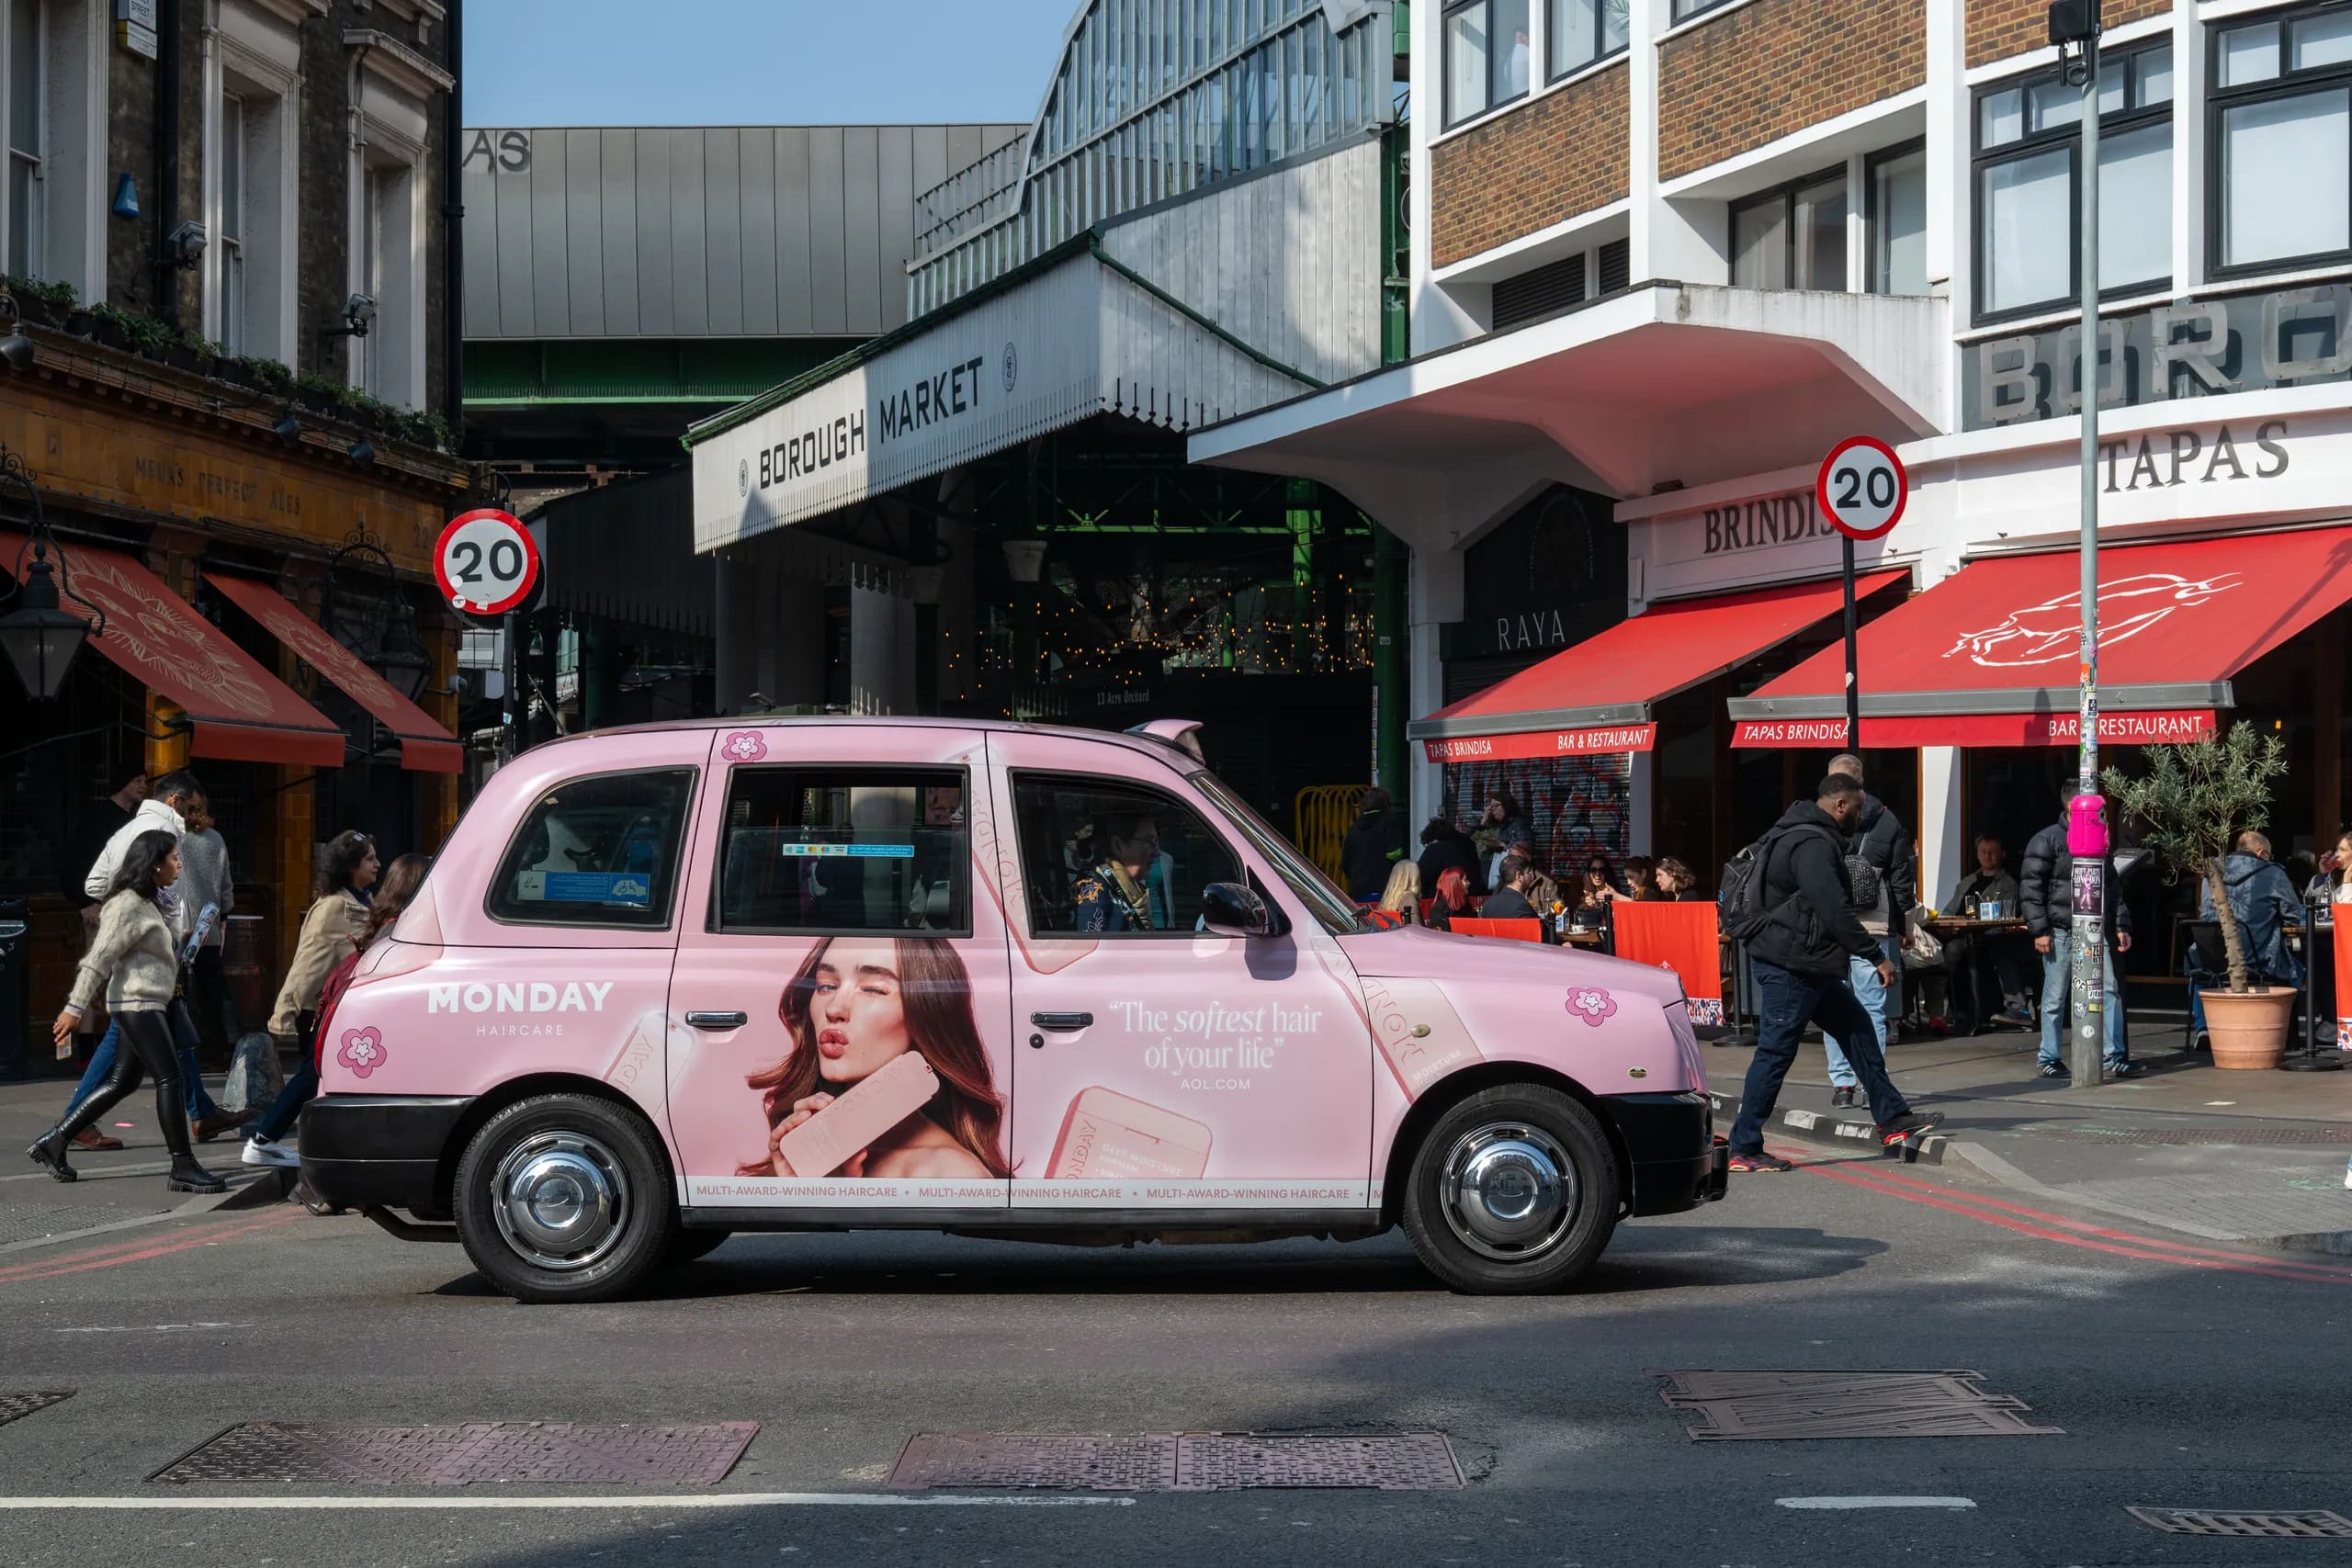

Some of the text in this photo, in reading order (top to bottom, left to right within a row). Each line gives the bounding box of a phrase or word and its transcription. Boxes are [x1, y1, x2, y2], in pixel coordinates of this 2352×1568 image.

[760, 409, 865, 490] BOROUGH
[879, 355, 983, 445] MARKET
[2098, 420, 2290, 494] TAPAS
[1834, 467, 1895, 509] 20
[452, 539, 523, 582] 20
[1498, 609, 1566, 652] RAYA
[1745, 724, 1849, 740] TAPAS BRINDISA
[2049, 719, 2077, 737] BAR
[2098, 716, 2203, 736] RESTAURANT
[1429, 739, 1493, 758] TAPAS BRINDISA
[1557, 728, 1650, 750] BAR & RESTAURANT
[426, 981, 615, 1014] MONDAY
[1173, 999, 1267, 1040] softest
[1272, 1001, 1323, 1033] hair
[476, 1025, 564, 1037] HAIRCARE
[1144, 1035, 1172, 1069] of
[1171, 1045, 1234, 1077] your
[1180, 1078, 1251, 1090] AOL.COM
[695, 1185, 898, 1198] MULTI-AWARD-WINNING HAIRCARE
[919, 1187, 1122, 1199] MULTI-AWARD-WINNING HAIRCARE
[1147, 1188, 1351, 1199] MULTI-AWARD-WINNING HAIRCARE
